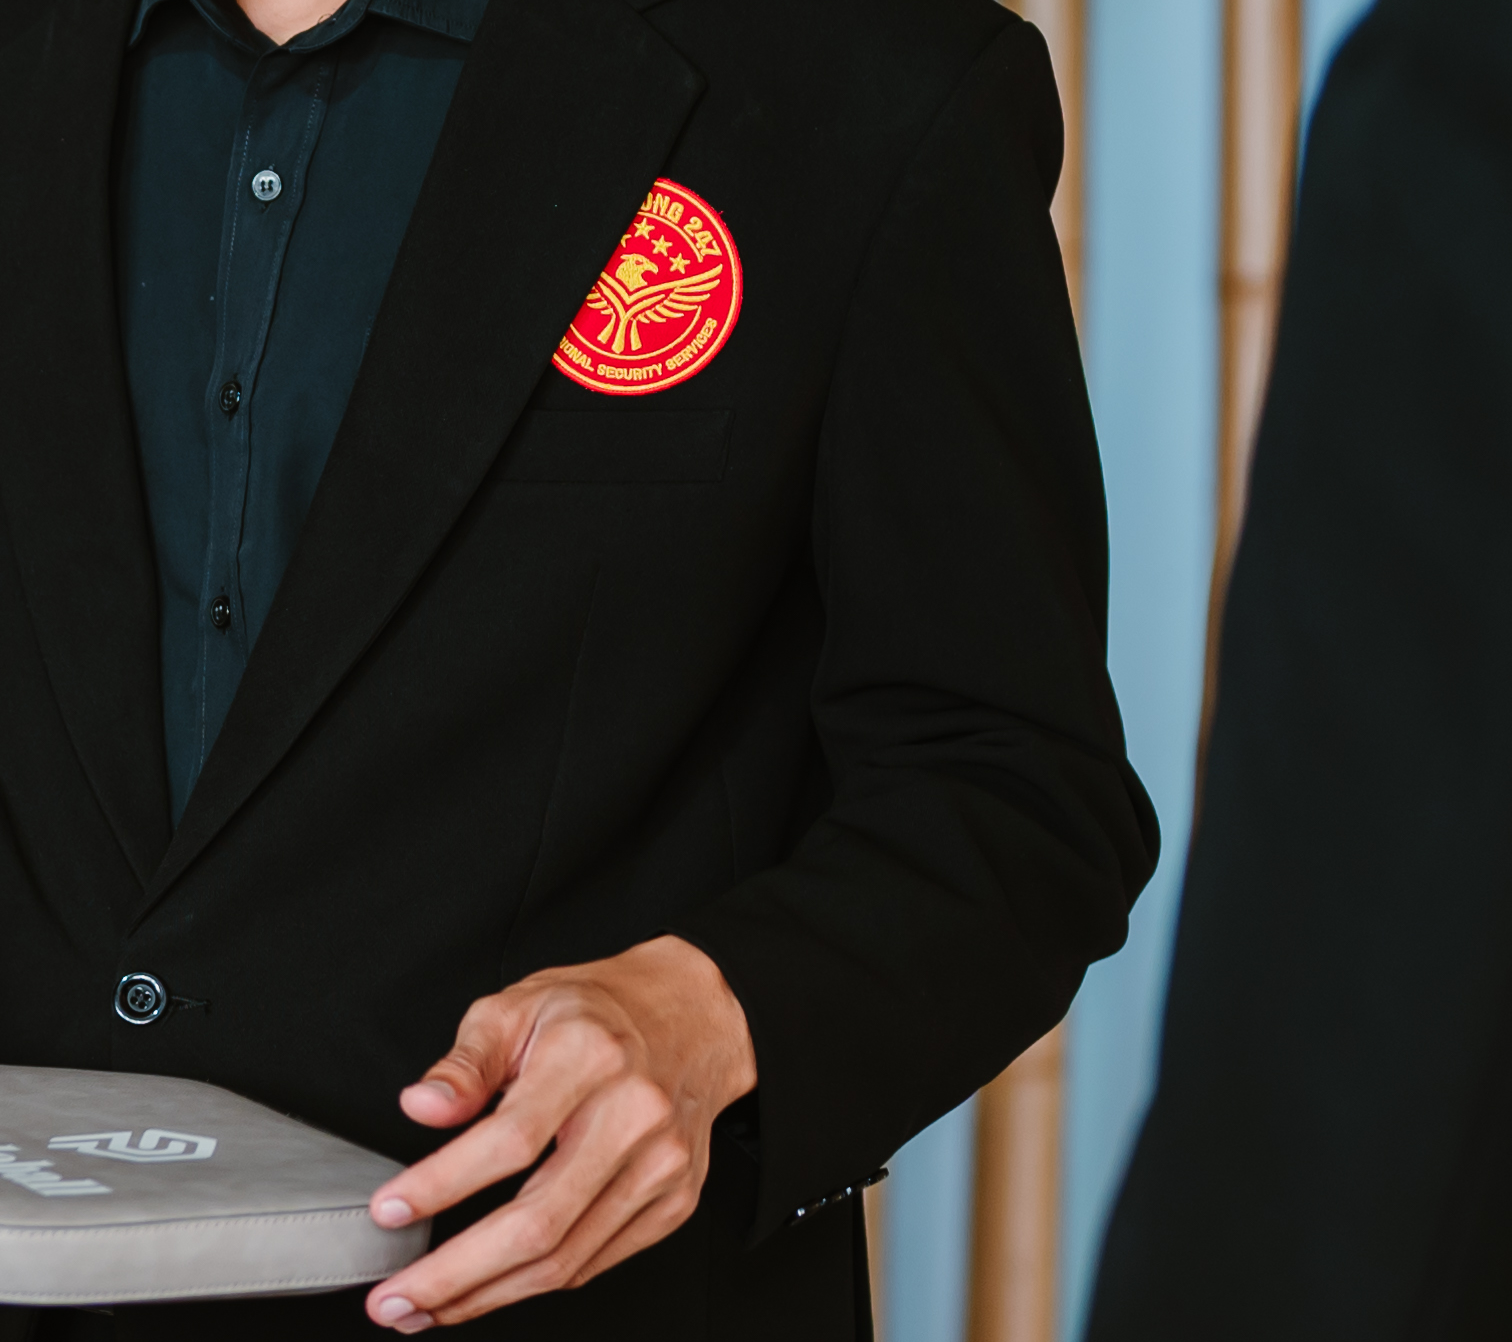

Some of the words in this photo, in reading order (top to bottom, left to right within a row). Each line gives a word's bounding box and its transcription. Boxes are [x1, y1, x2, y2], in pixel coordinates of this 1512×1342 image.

[683, 216, 723, 257] 247
[596, 363, 663, 381] SECURITY
[664, 317, 718, 371] SERVICES
